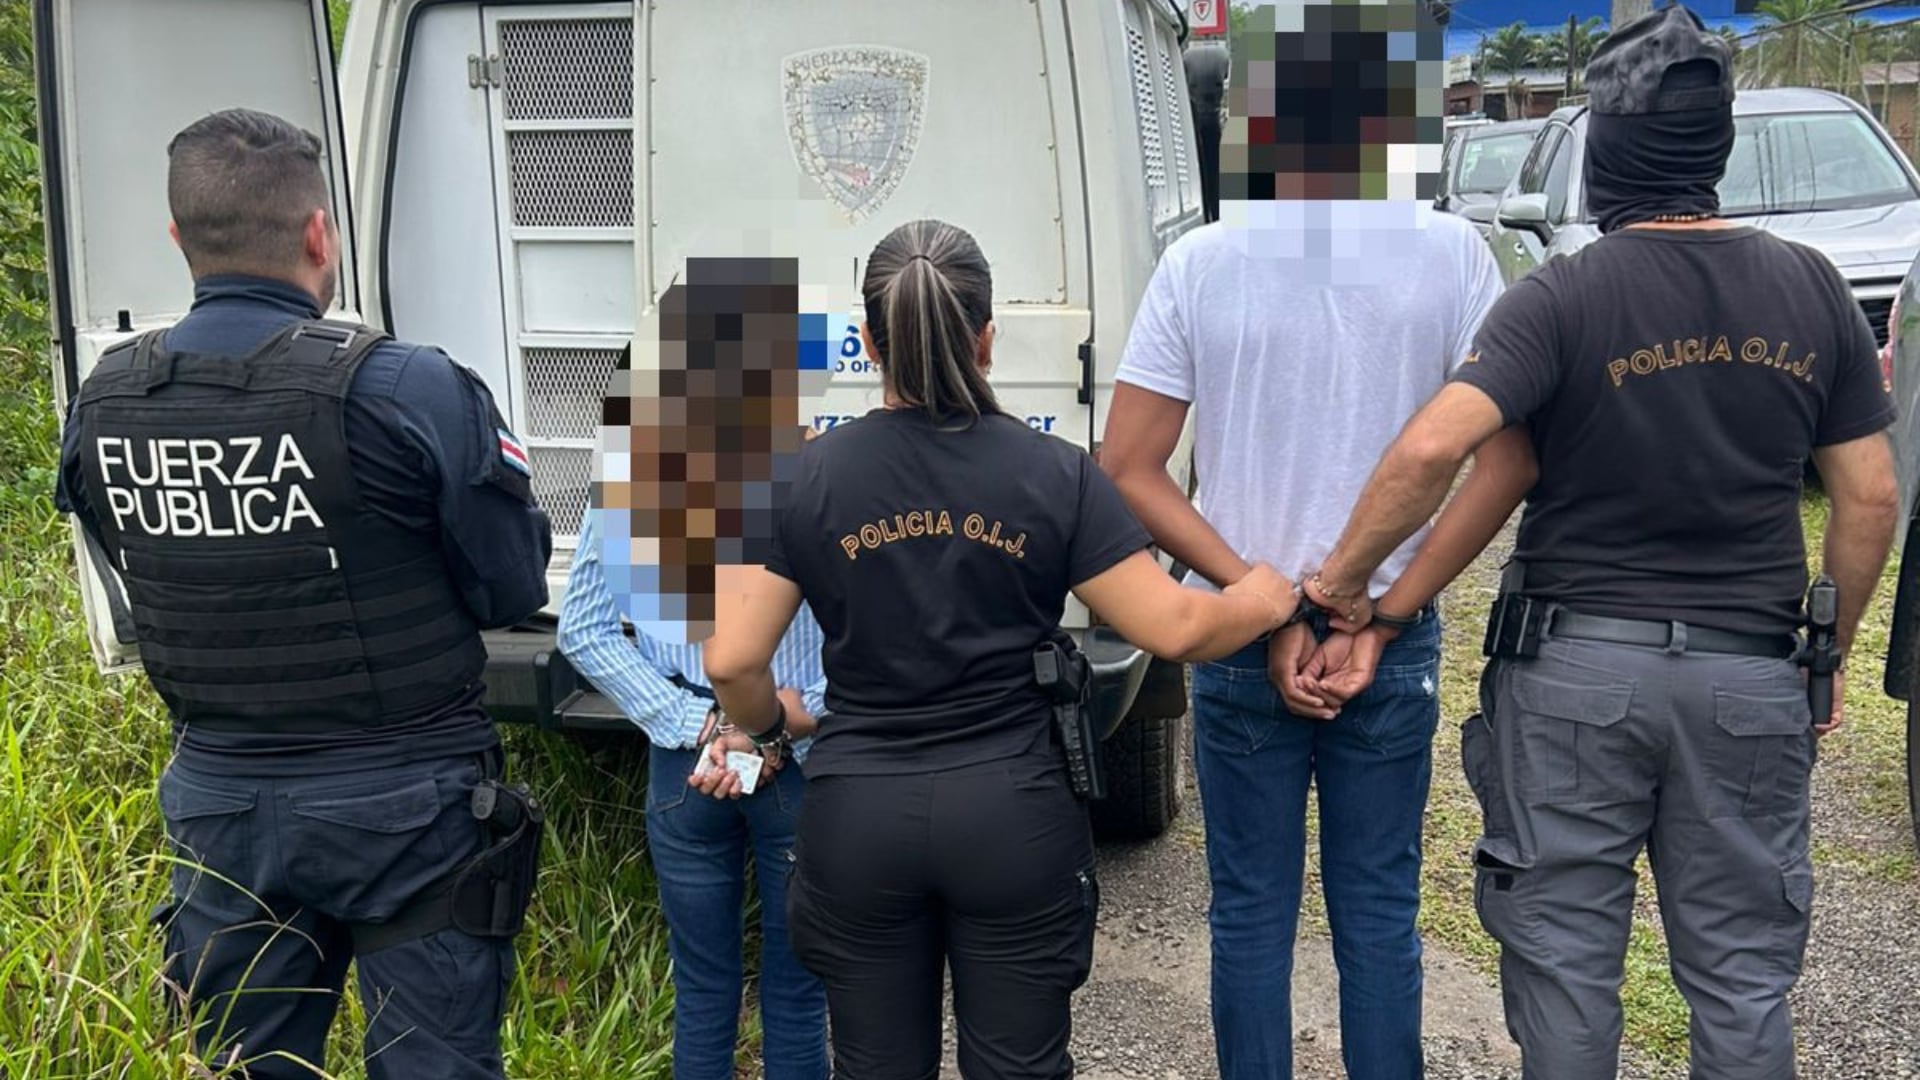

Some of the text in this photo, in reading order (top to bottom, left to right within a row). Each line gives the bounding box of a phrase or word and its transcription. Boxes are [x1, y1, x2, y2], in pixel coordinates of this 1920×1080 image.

[1607, 335, 1817, 388] POLICIA O.I.J.
[97, 433, 315, 487] FUERZA
[106, 484, 325, 537] PUBLICA
[840, 510, 1027, 560] POLICIA O.I.J.
